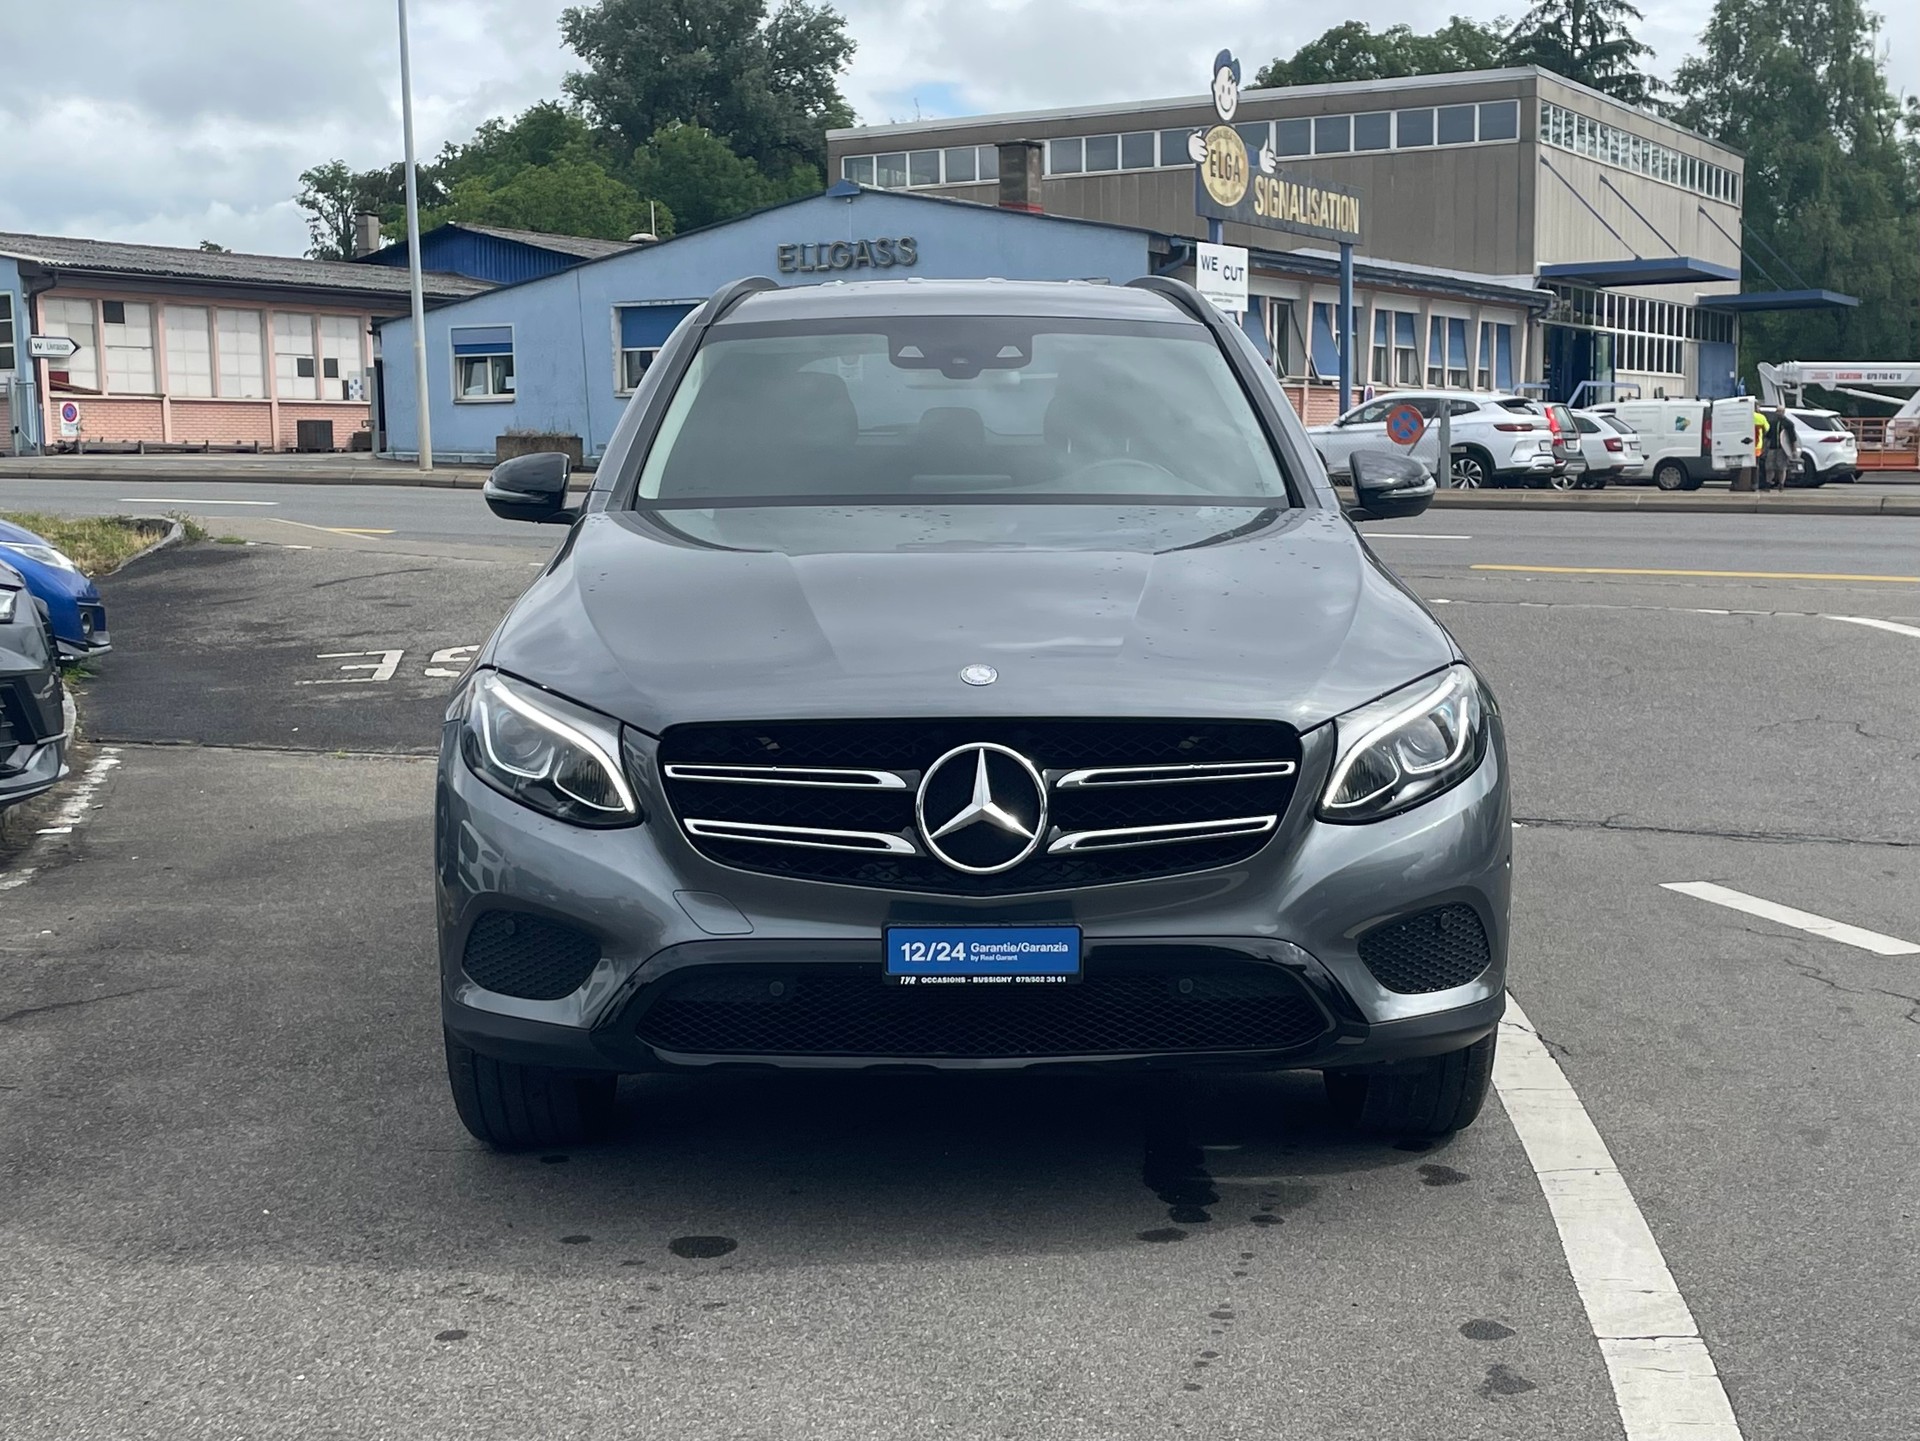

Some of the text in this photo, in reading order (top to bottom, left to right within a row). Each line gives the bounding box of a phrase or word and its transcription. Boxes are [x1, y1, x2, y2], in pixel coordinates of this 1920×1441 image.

[1210, 149, 1241, 183] ELGA
[1254, 175, 1360, 235] SIGNALISATION
[777, 236, 918, 273] ELLGASS
[1200, 254, 1245, 282] WE CUT
[900, 942, 966, 962] 12/24
[970, 942, 1069, 953] Garantie/Garanzia
[970, 954, 979, 963] by
[921, 976, 966, 984] OCCASIONS
